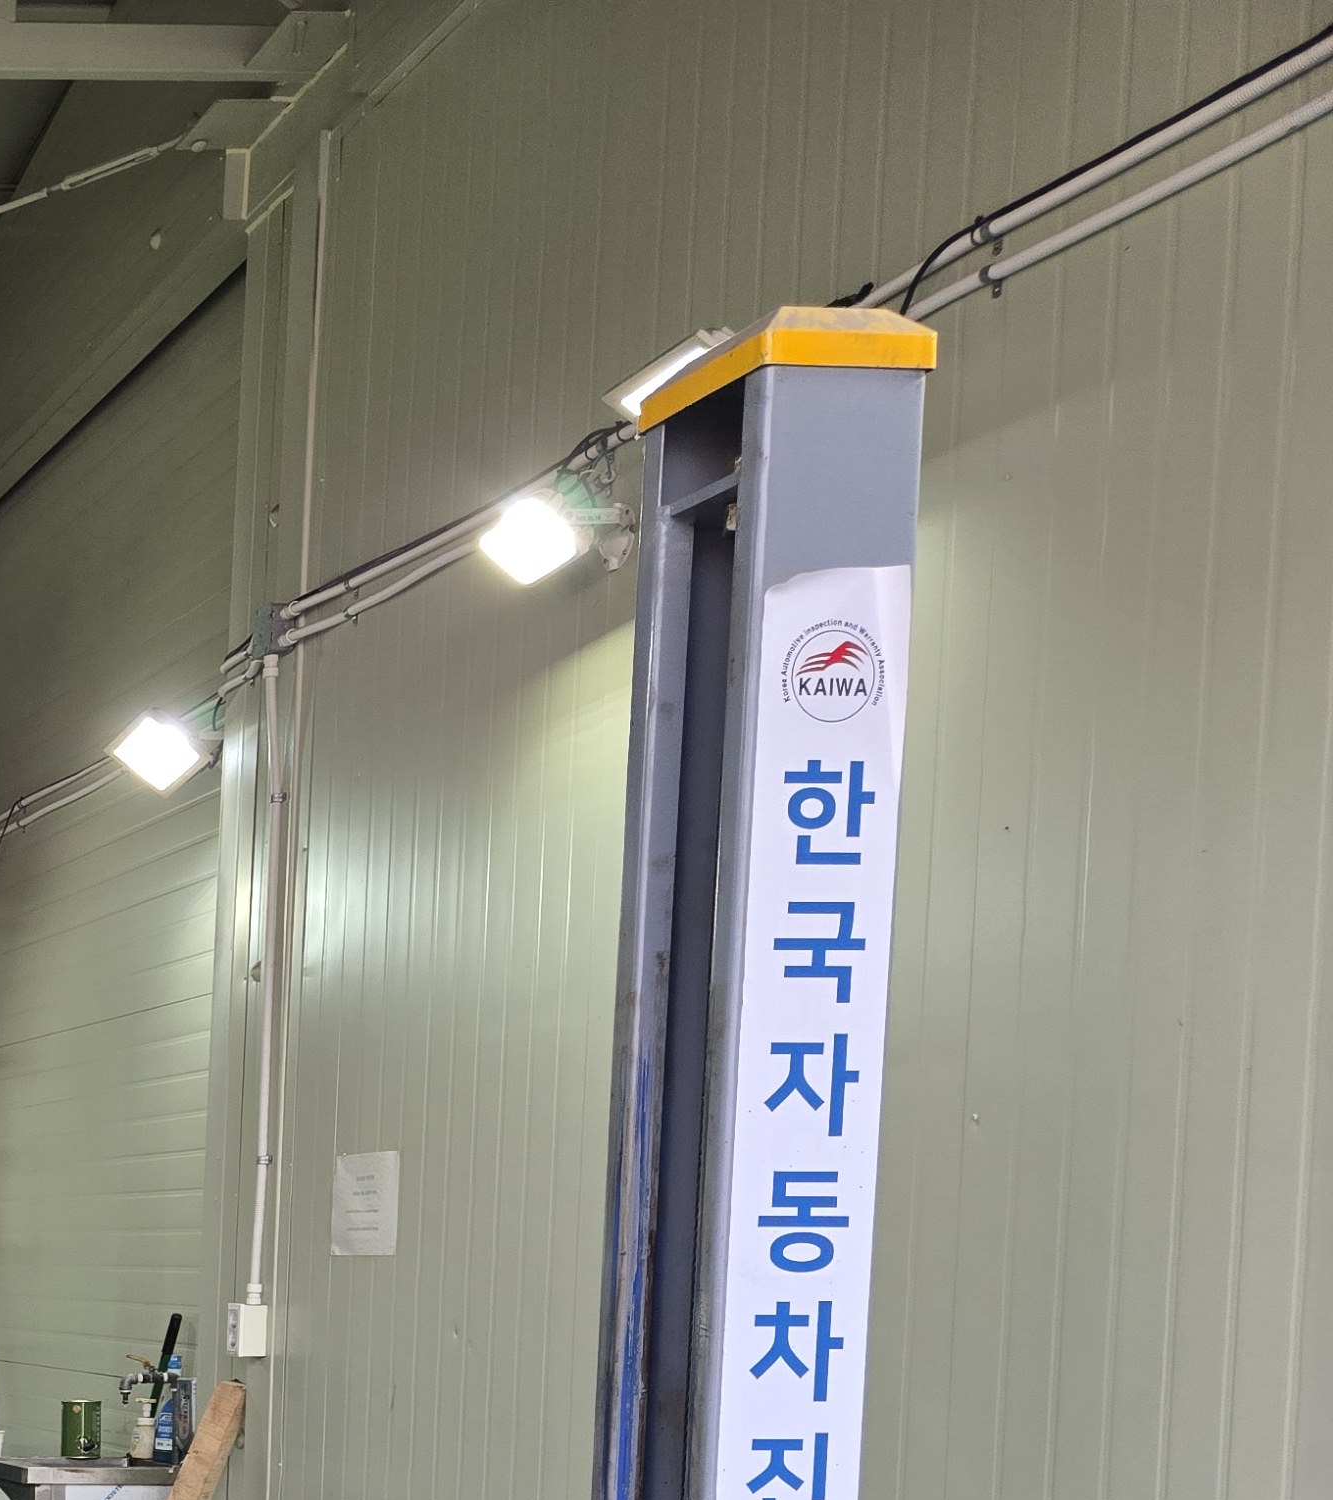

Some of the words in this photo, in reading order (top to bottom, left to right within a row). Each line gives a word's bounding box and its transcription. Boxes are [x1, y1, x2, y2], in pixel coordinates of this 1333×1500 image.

[844, 621, 859, 631] and
[781, 634, 804, 676] Automotive
[858, 627, 882, 657] Warranty
[781, 679, 791, 703] Korea
[799, 677, 868, 697] KAIWA
[871, 660, 885, 706] Association
